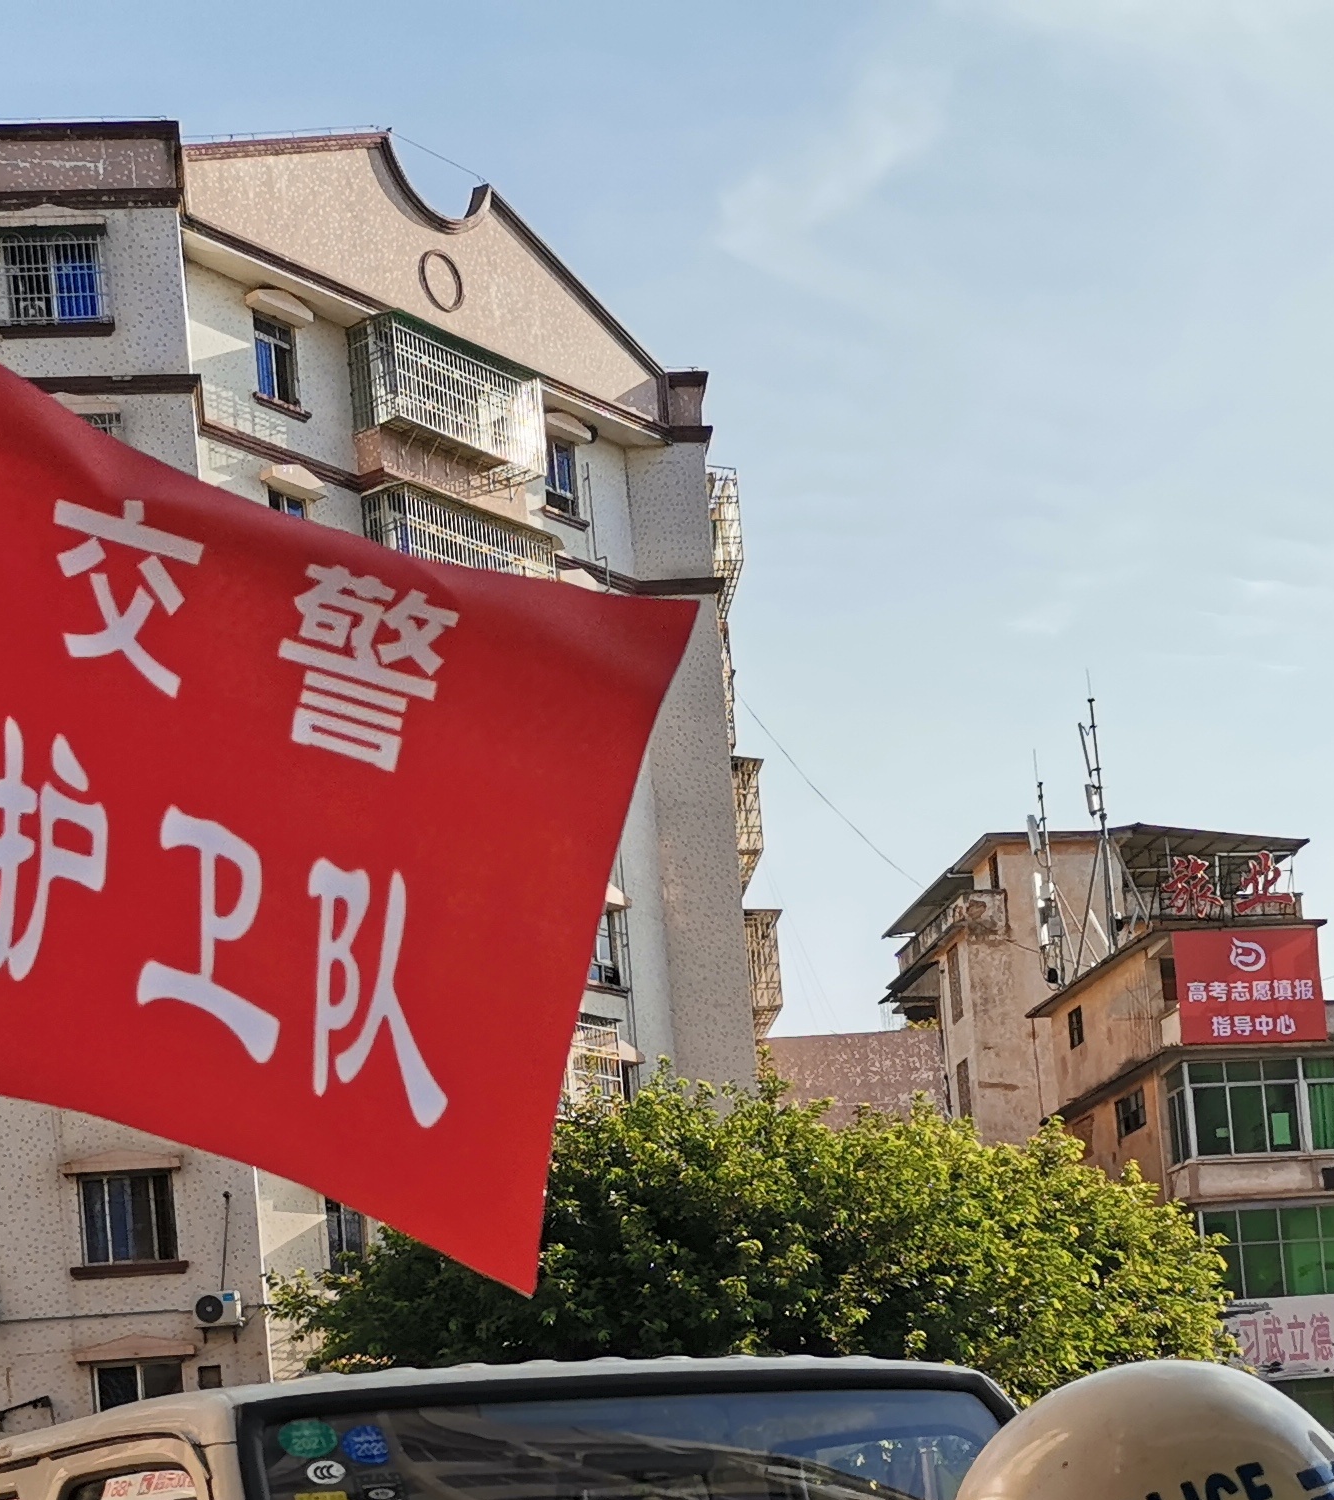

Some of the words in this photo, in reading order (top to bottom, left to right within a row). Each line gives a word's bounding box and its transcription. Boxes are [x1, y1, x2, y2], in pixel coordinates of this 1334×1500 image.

[1165, 850, 1295, 917] 旅业
[1186, 978, 1315, 1003] 高考志愿填报
[1211, 1014, 1297, 1037] 指导中心
[1239, 1311, 1334, 1365] 习武立德
